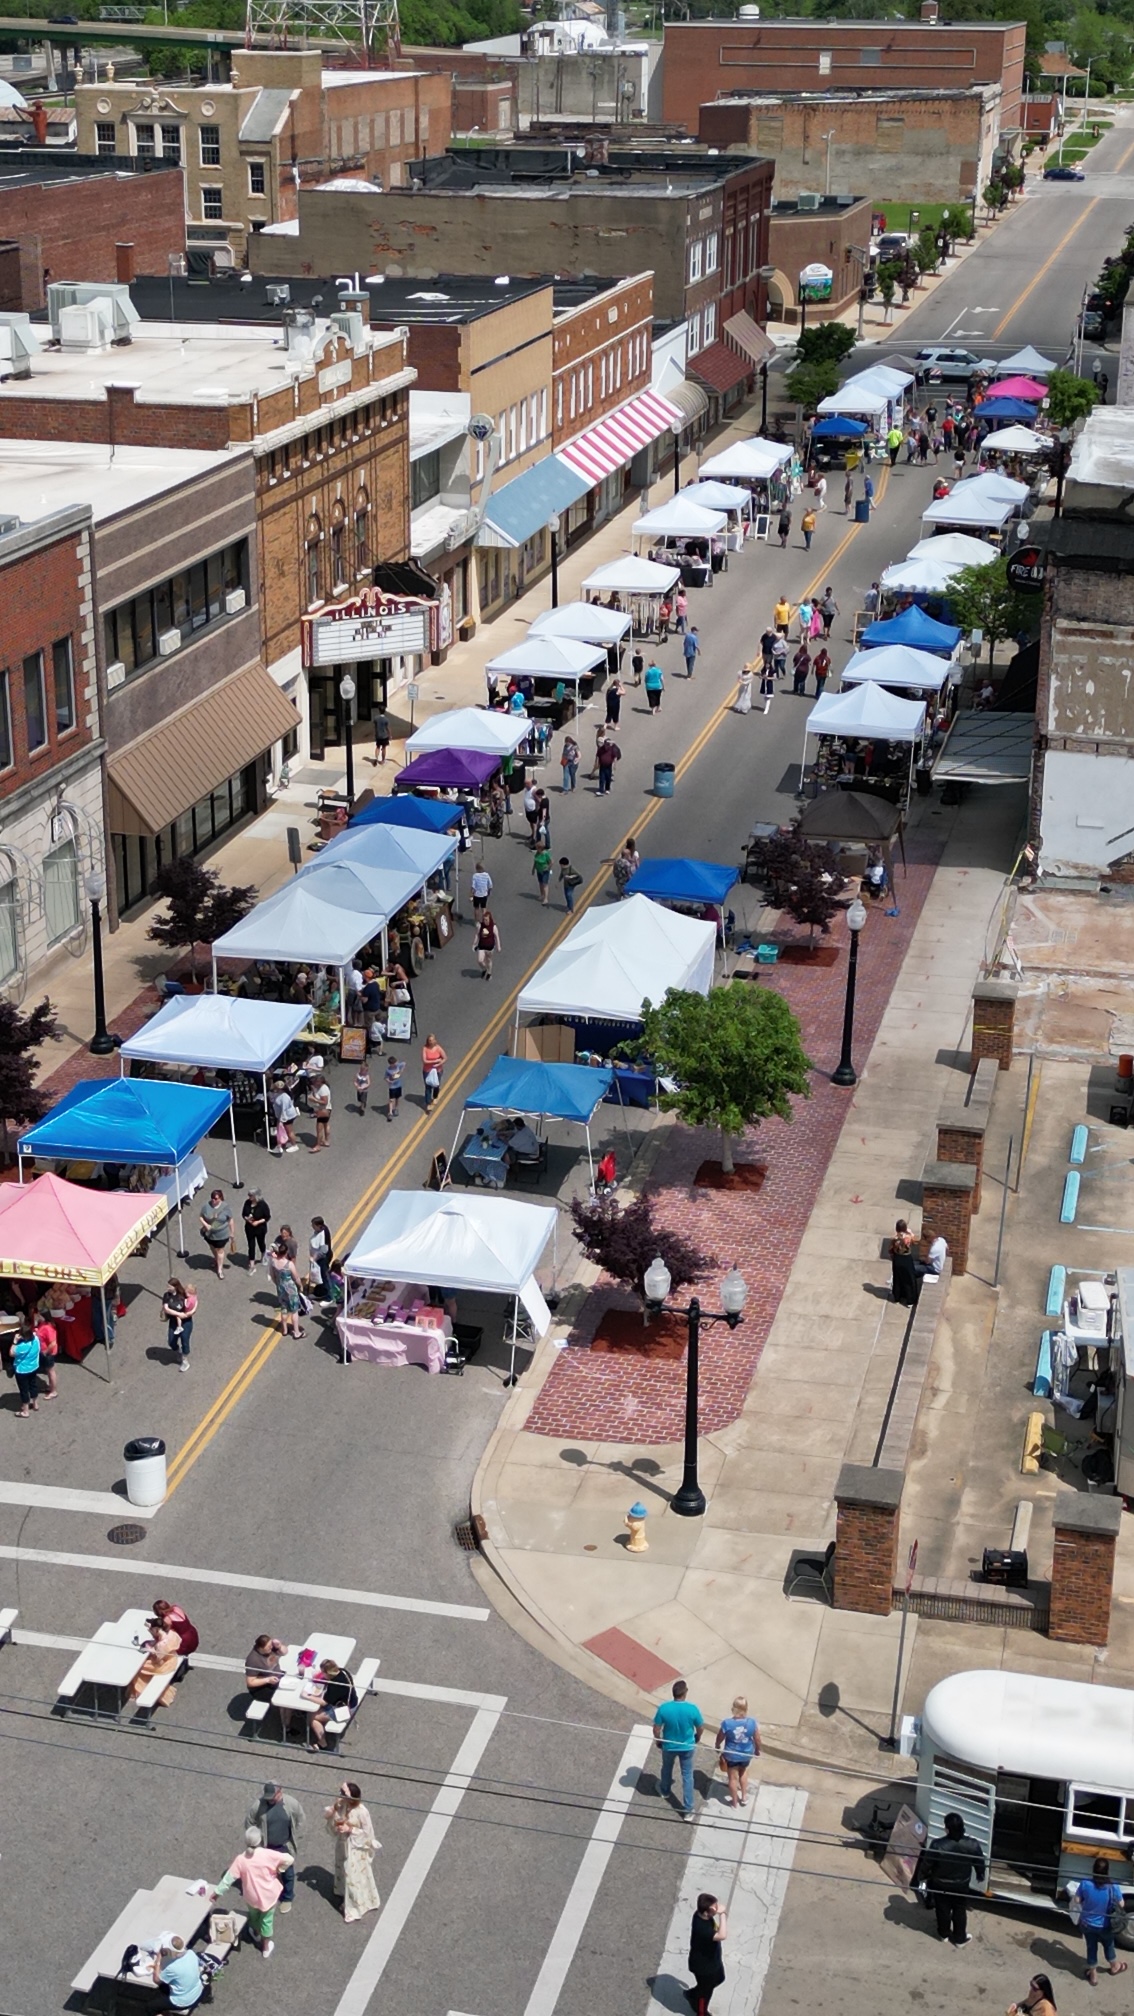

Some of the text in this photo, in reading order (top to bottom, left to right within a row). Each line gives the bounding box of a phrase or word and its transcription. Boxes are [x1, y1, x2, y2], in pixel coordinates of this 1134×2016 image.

[1010, 564, 1030, 577] FIRE
[335, 603, 406, 619] ILLINOIS
[30, 1264, 87, 1281] CORN
